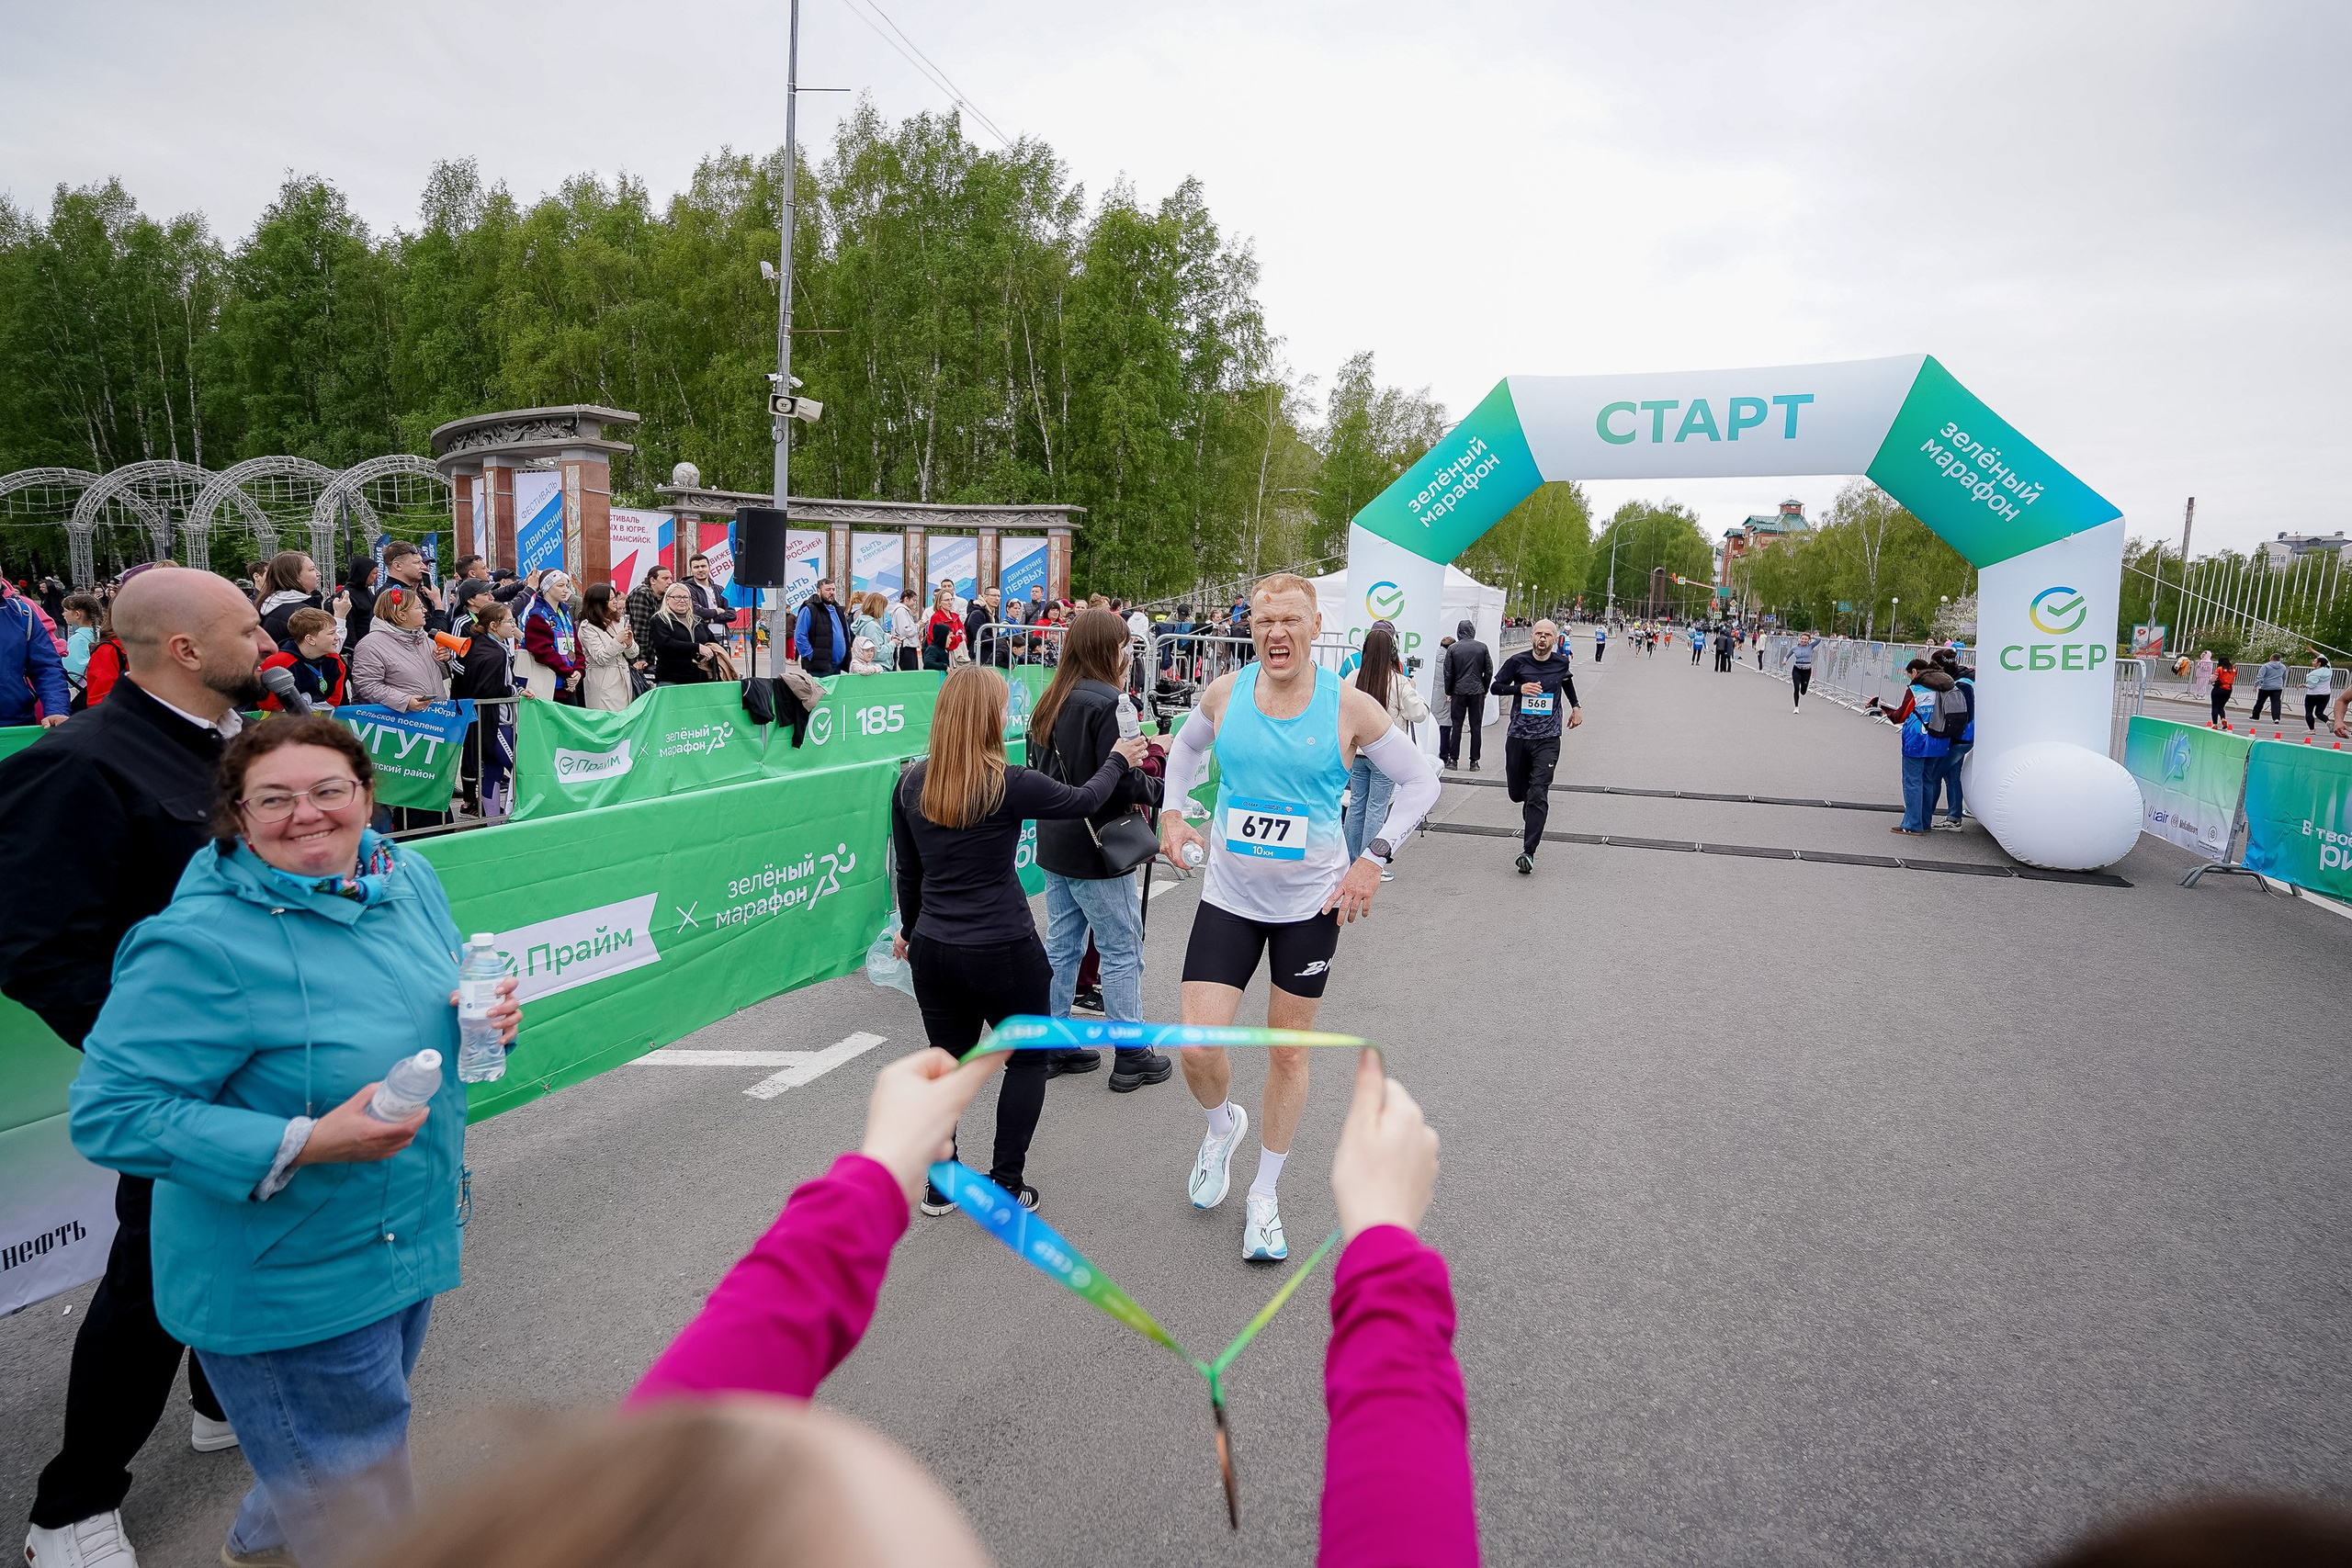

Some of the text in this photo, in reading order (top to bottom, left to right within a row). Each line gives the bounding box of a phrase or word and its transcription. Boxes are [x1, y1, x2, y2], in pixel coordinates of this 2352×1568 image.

[1596, 393, 1815, 445] СТАРТ
[1408, 436, 1488, 513] зелёный
[1939, 422, 2045, 505] зелёный
[1419, 453, 1501, 528] марафон
[1919, 438, 2020, 523] марафон
[521, 480, 559, 519] ФЕСТИВАЛЬ
[786, 539, 804, 551] ЫТЬ
[860, 539, 882, 554] БЫТЬ
[863, 538, 899, 562] ДВИЖЕНИИ
[932, 541, 974, 567] БЫТЬ ВМЕСТЕ
[1005, 543, 1038, 564] ФЕСТИВАЛЬ
[1005, 567, 1045, 595] ПЕРВЫХ
[1007, 557, 1044, 583] ДВИЖЕНИЕ
[786, 577, 809, 595] ЫТЬ
[786, 583, 819, 606] ЕРВЫ
[1349, 626, 1421, 653] СР
[1999, 644, 2108, 671] СБЕР
[1528, 699, 1547, 708] 568
[356, 709, 445, 733] сельское поселение
[855, 704, 905, 736] 185
[348, 718, 446, 765] УГУТ
[665, 724, 710, 743] зелёный
[659, 739, 707, 758] марафон
[403, 768, 435, 780] район
[575, 755, 621, 773] Прайм
[1241, 815, 1291, 841] 677
[728, 852, 815, 898] зелёный
[716, 885, 808, 930] марафон
[527, 925, 634, 976] Прайм
